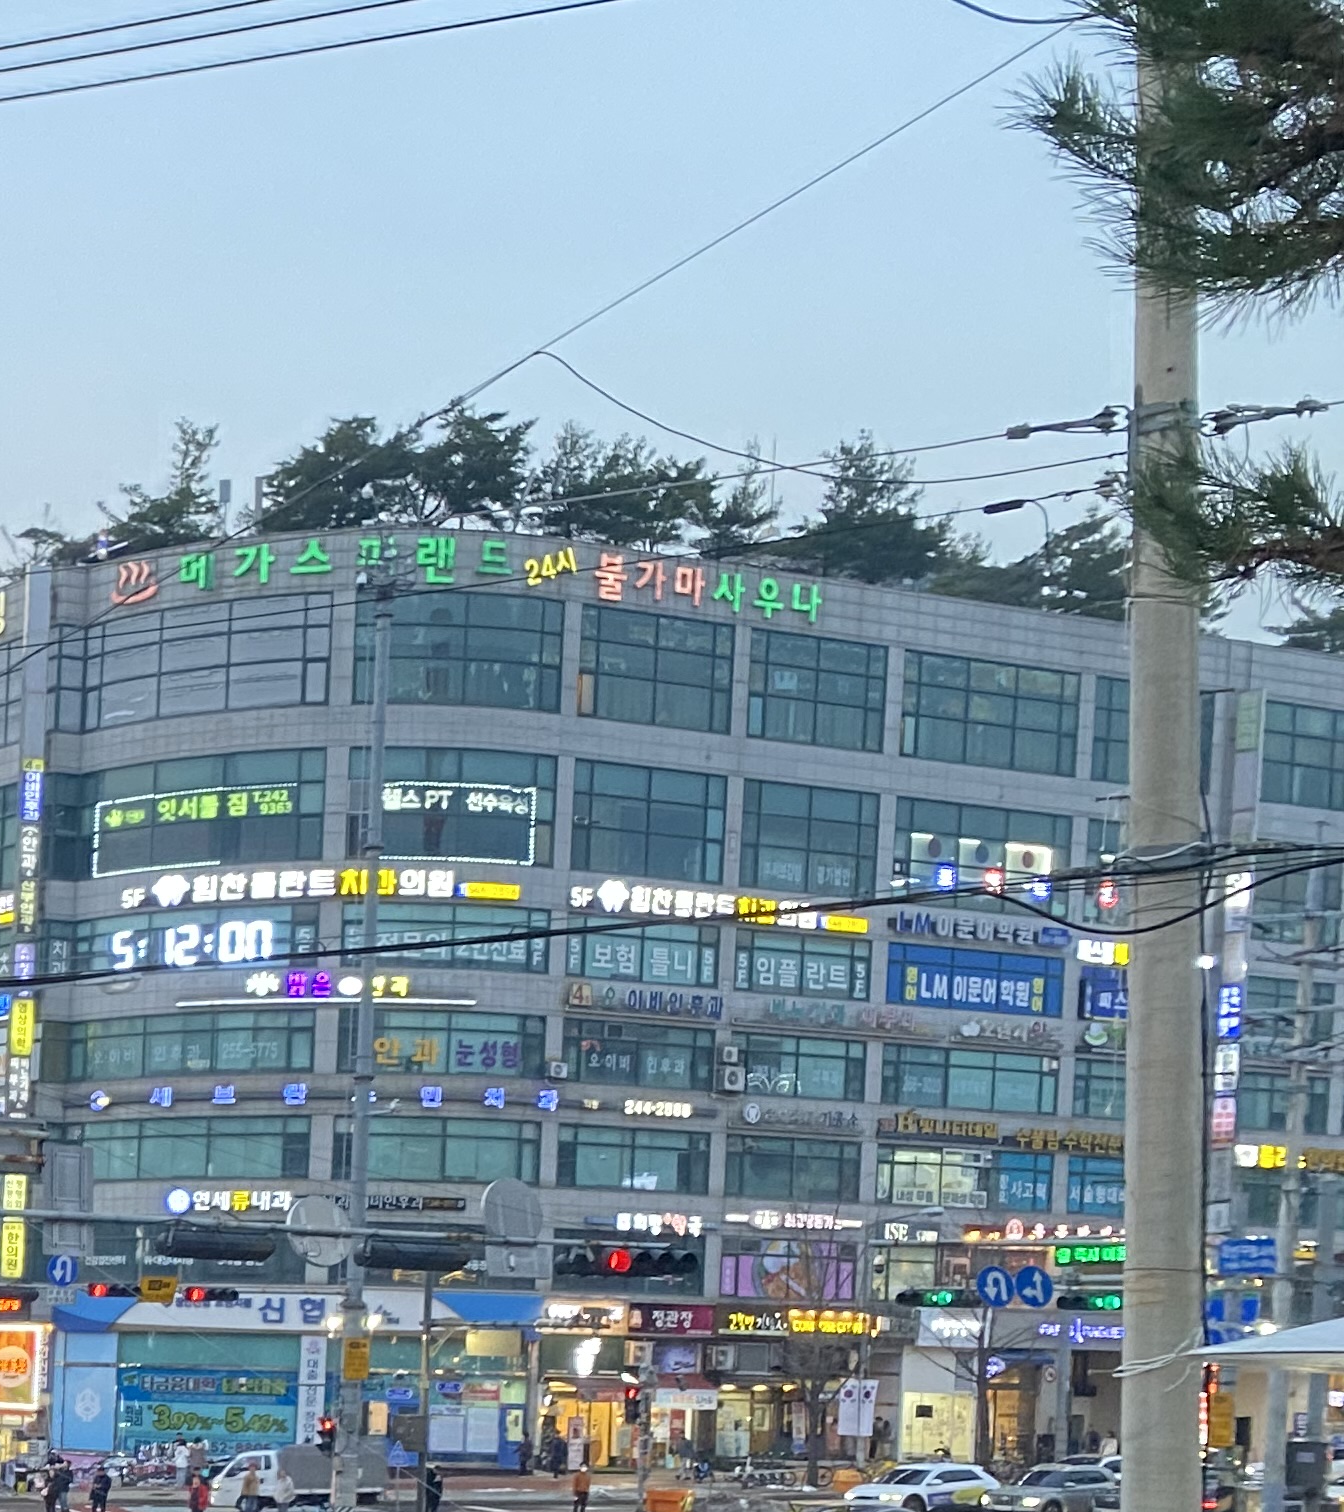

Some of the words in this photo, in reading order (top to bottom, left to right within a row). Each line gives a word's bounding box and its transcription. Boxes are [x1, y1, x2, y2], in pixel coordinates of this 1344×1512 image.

[524, 546, 578, 587] 24시
[424, 790, 453, 810] PT
[593, 944, 637, 984] 보험
[757, 955, 848, 992] 임플란트
[920, 972, 948, 999] LM
[373, 1037, 441, 1066] 안과
[455, 1039, 521, 1068] 눈성형
[192, 1190, 293, 1211] 연세류내과
[6, 1232, 19, 1270] 한의원
[258, 1297, 326, 1324] 신협
[651, 1309, 694, 1328] 정관장
